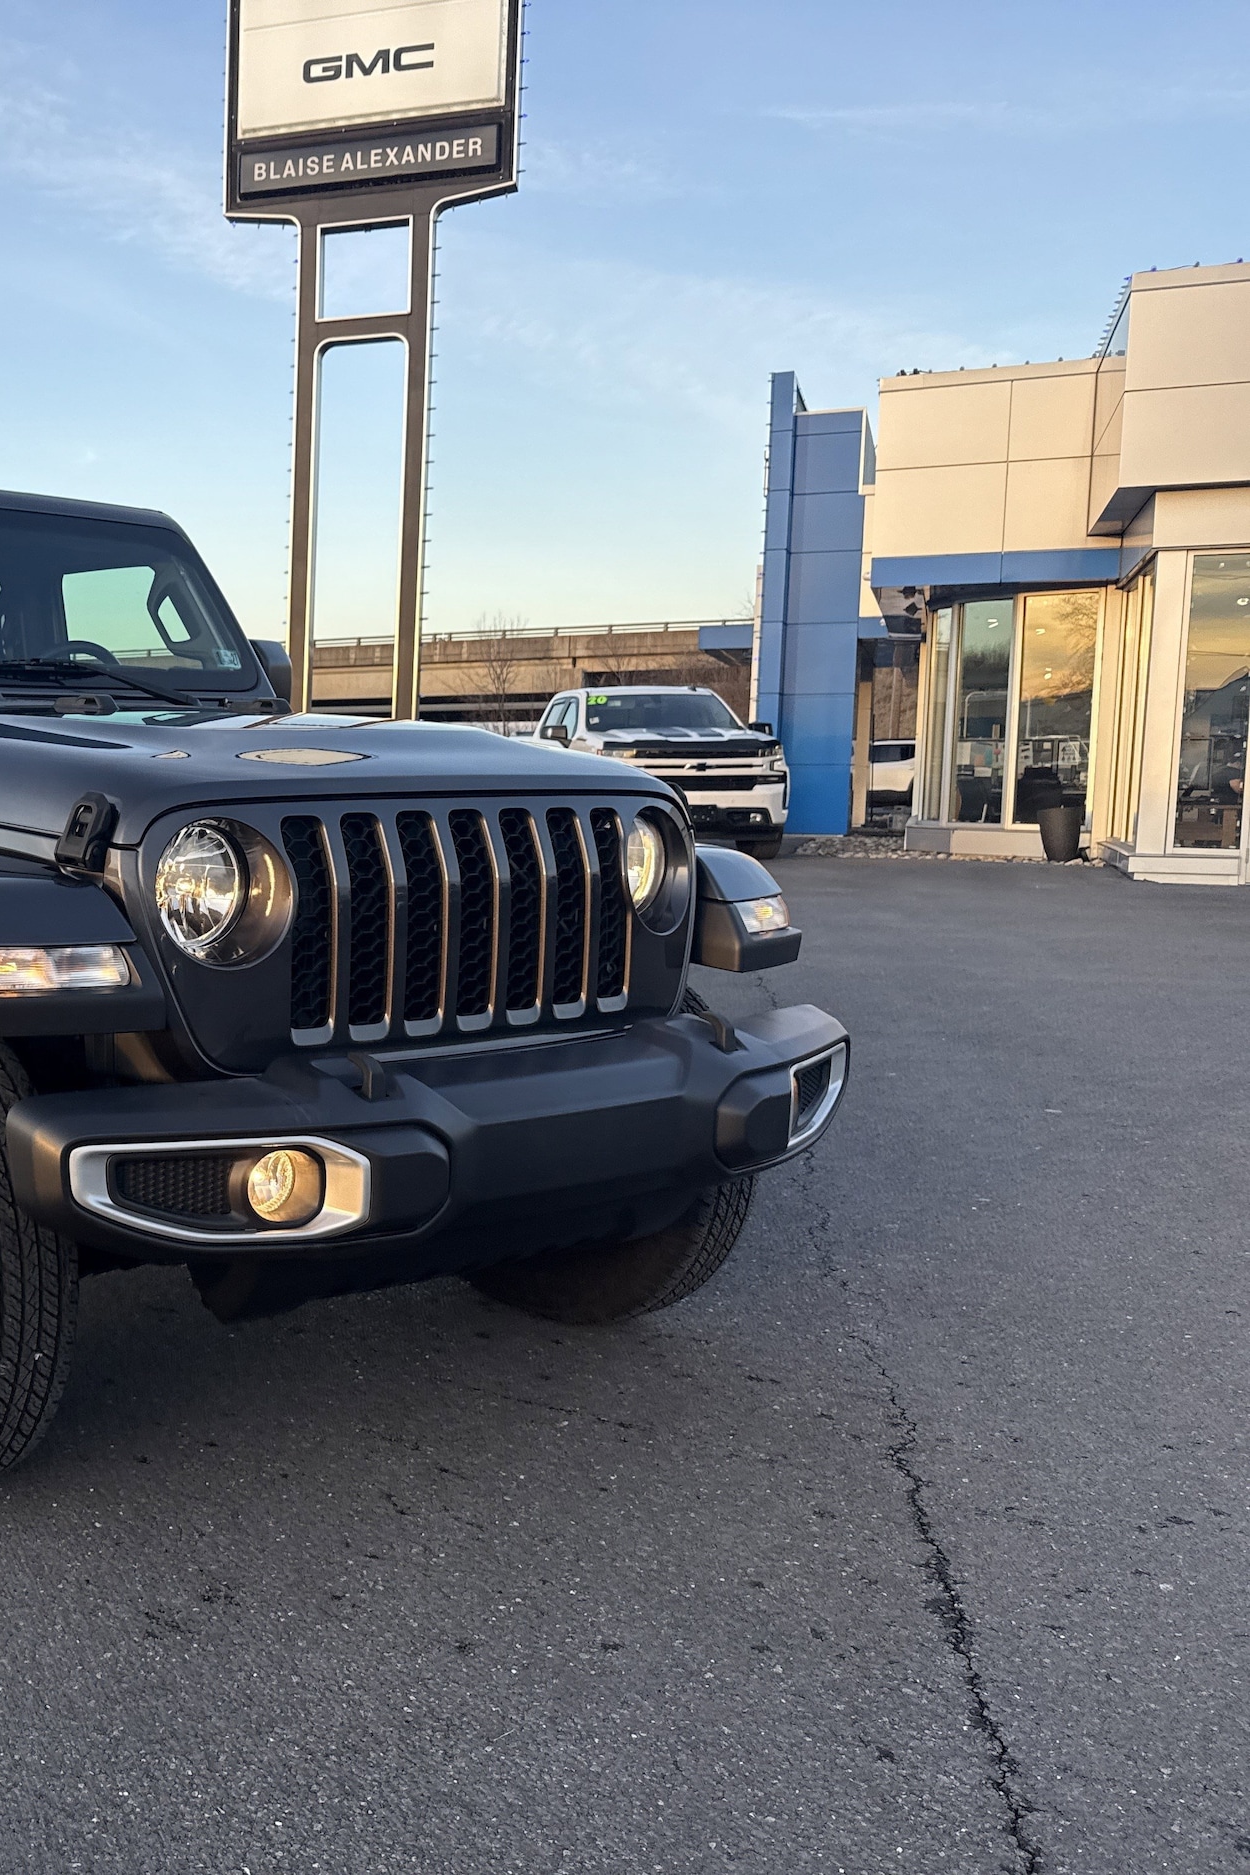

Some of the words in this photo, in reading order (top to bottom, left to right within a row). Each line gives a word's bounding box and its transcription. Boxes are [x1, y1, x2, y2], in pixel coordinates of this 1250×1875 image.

[303, 43, 434, 83] GMC
[253, 155, 334, 182] BLAISE
[340, 136, 482, 171] ALEXANDER
[587, 695, 608, 706] 20
